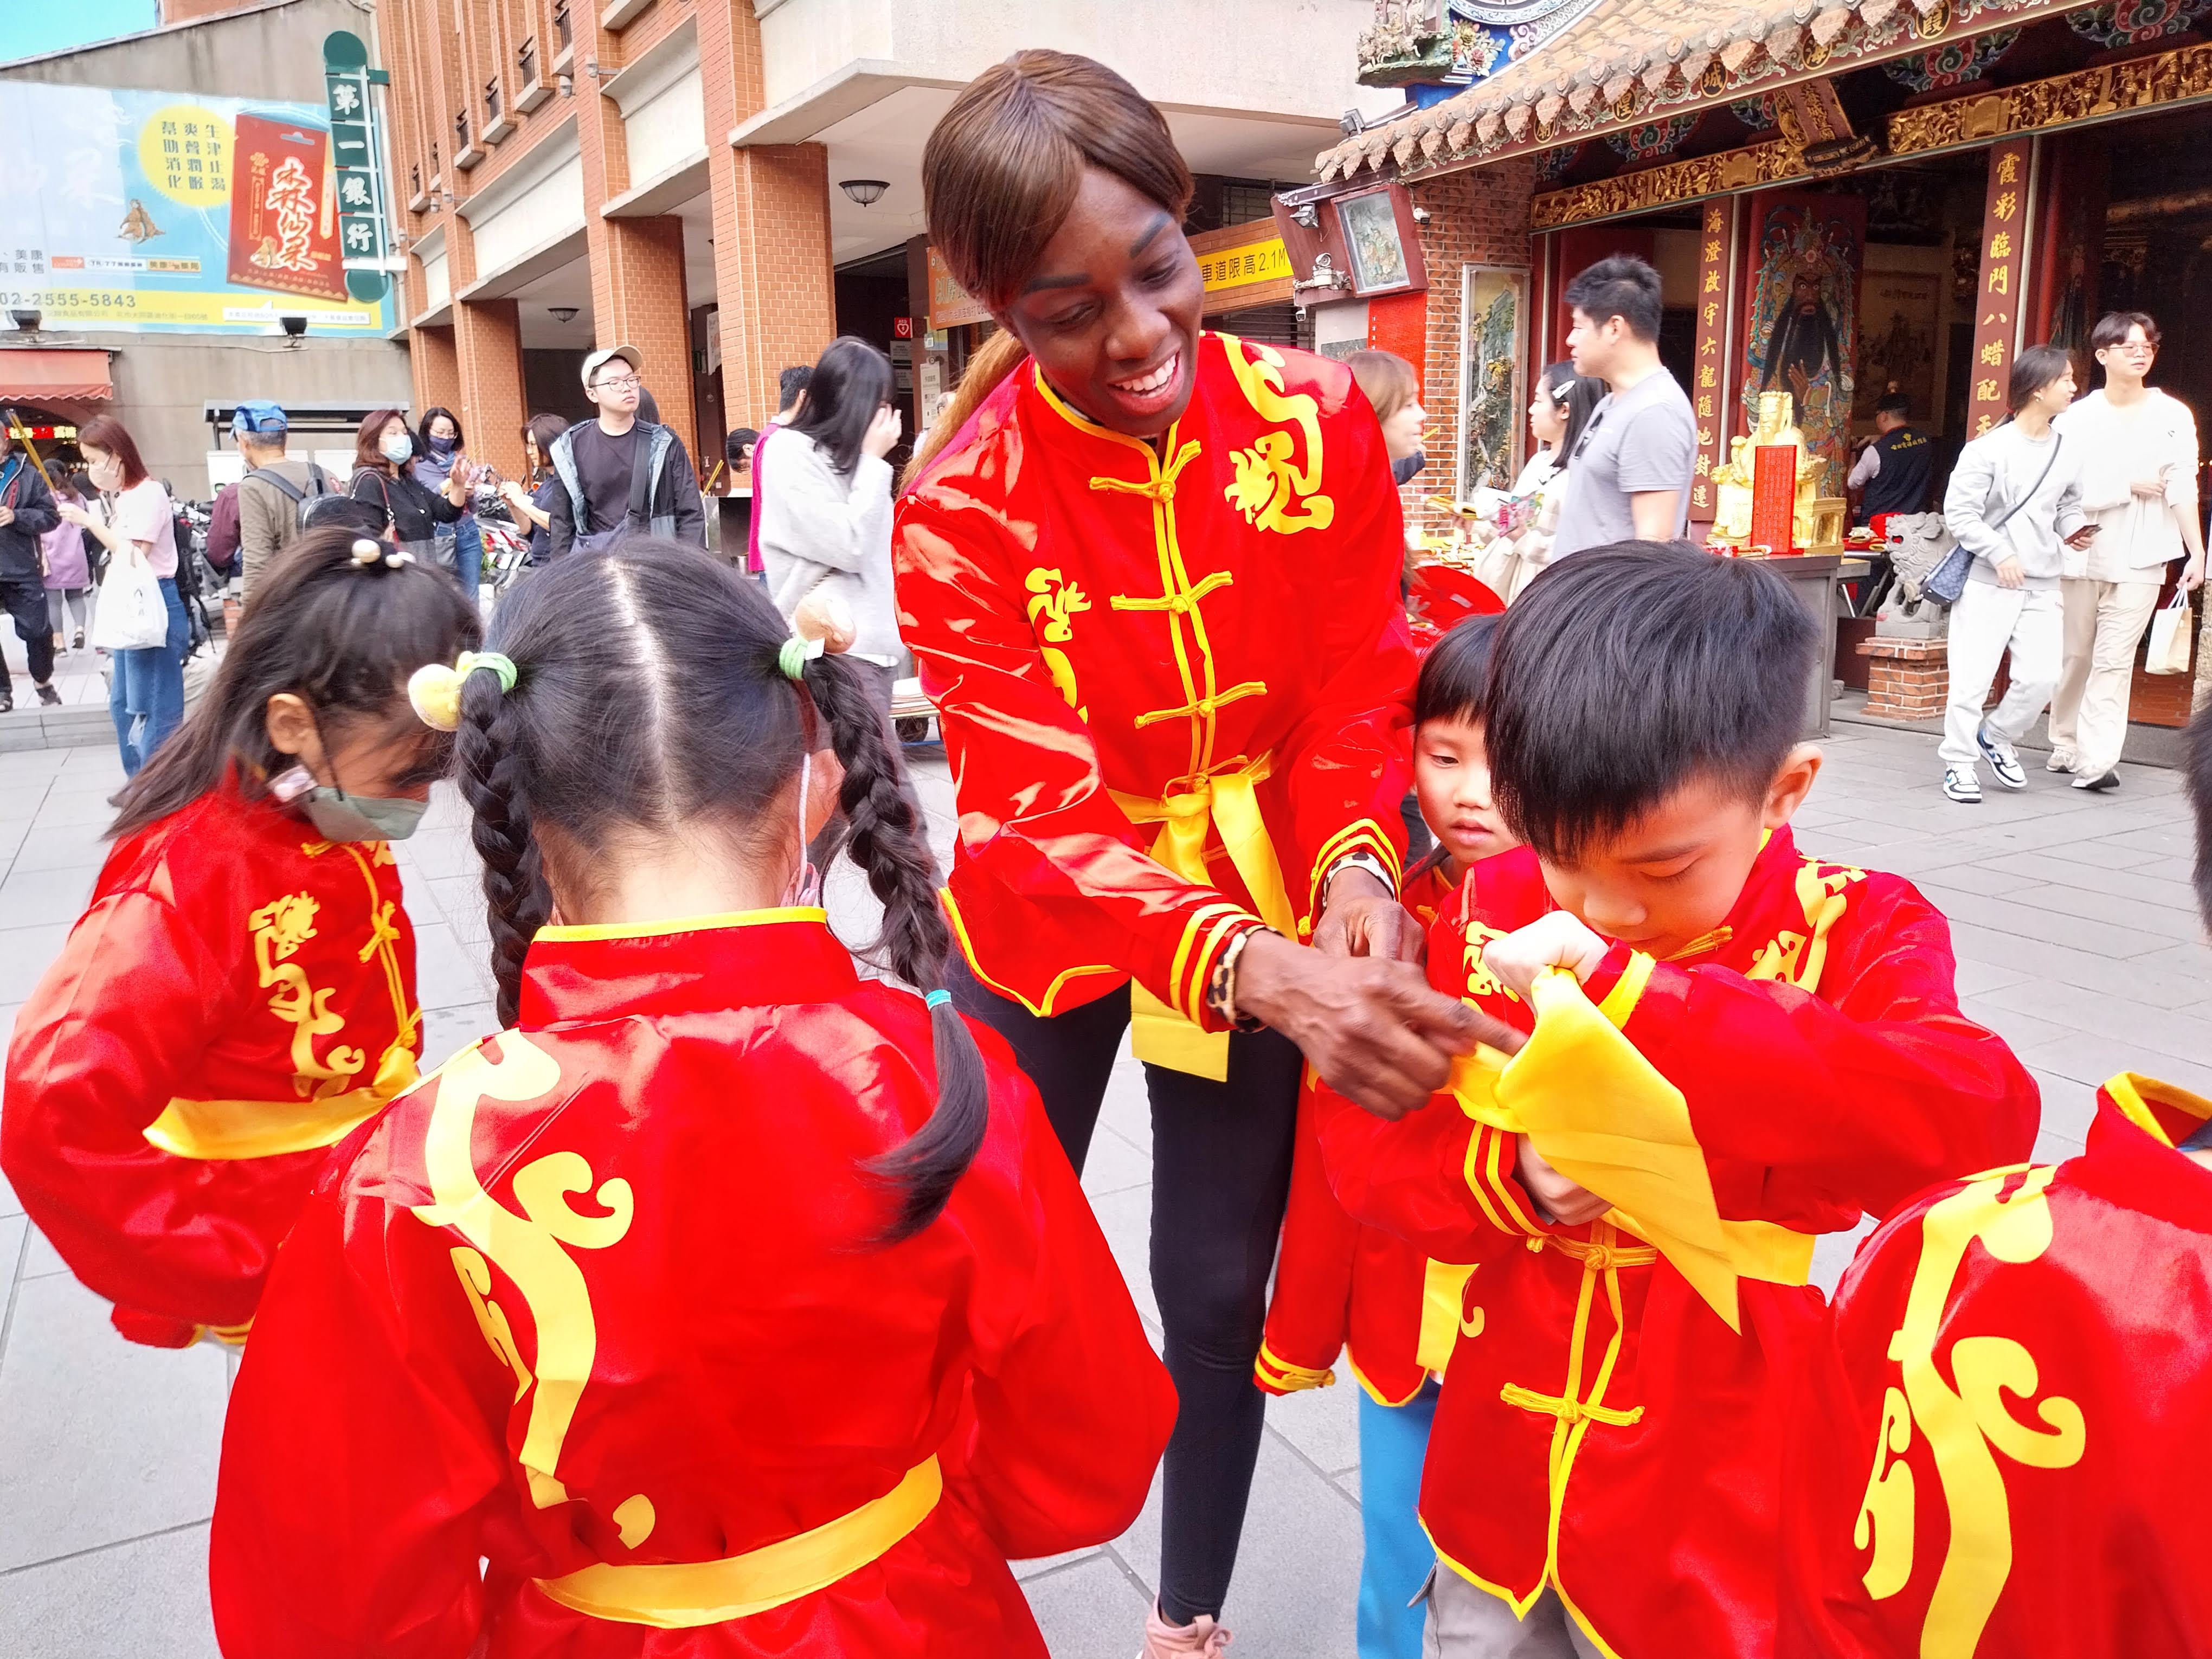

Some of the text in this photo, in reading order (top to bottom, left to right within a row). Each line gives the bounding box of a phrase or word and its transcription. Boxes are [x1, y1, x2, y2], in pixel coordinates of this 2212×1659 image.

[333, 85, 374, 252] 第一銀行
[0, 292, 136, 307] 02-2555-5843
